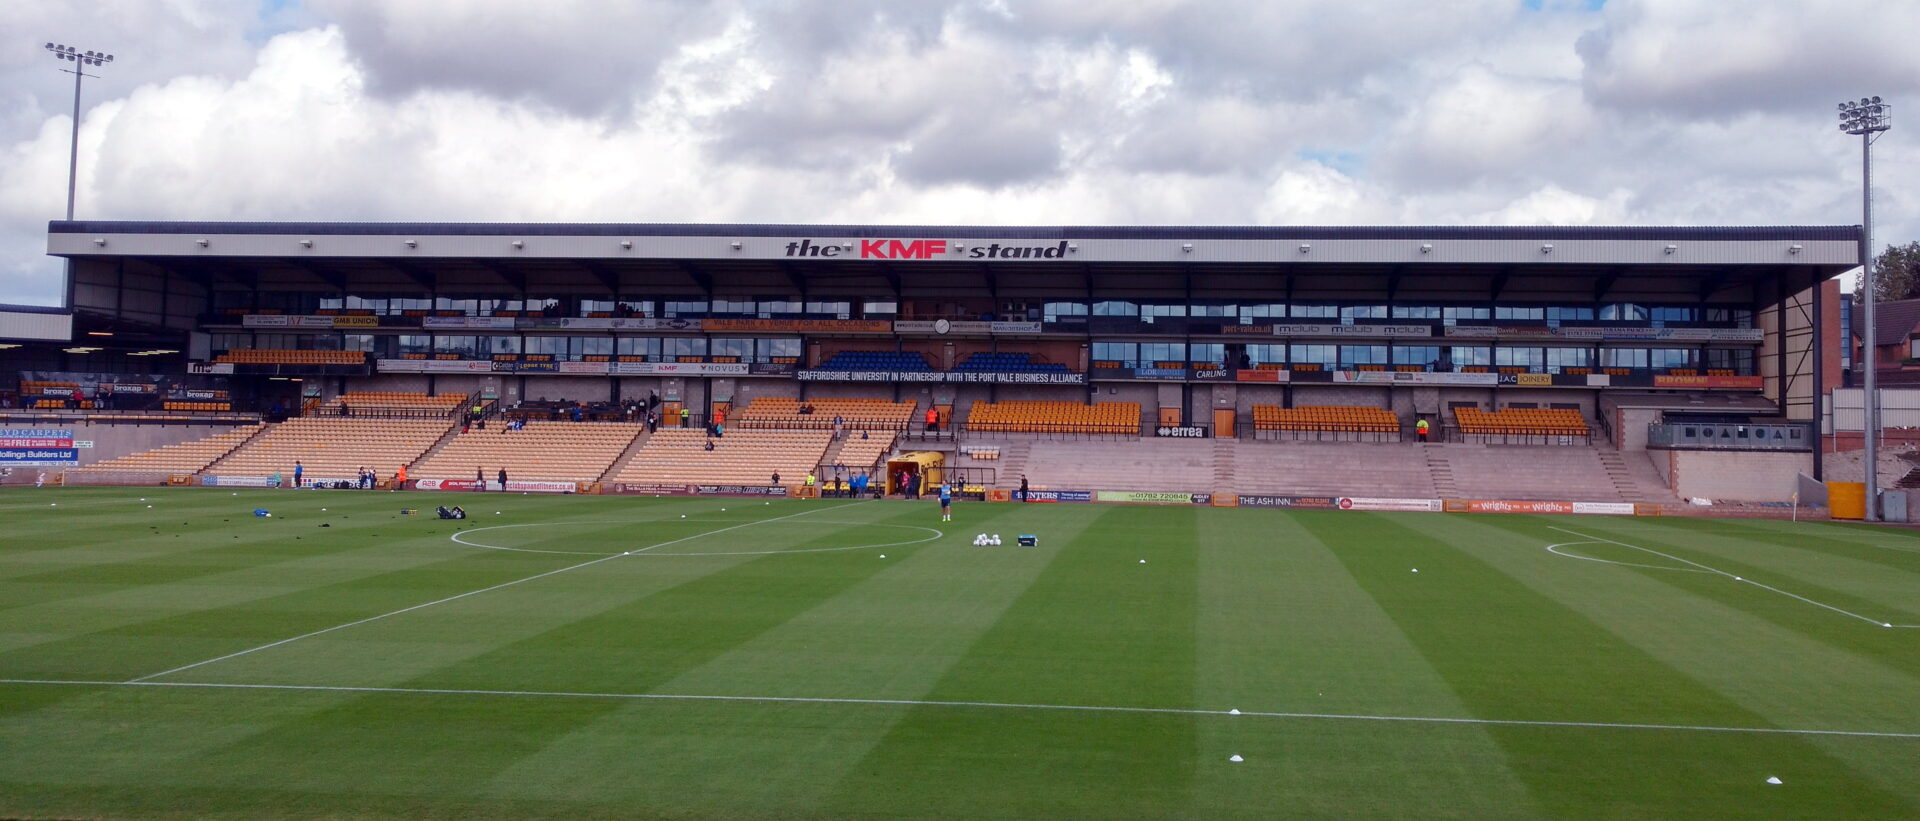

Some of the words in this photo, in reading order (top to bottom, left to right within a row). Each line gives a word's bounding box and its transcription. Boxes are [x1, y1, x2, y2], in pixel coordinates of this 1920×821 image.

[785, 239, 841, 257] the
[861, 240, 946, 259] KMF
[969, 240, 1068, 258] stand
[798, 371, 850, 381] STAFFORDSHIRE
[852, 372, 889, 381] UNIVERSITY
[892, 372, 898, 381] IN
[900, 372, 944, 382] PARTNERSHIP
[946, 372, 962, 382] WITH
[964, 372, 977, 382] THE
[978, 373, 995, 382] PORT
[997, 373, 1014, 382] VALE
[1016, 374, 1048, 383] BUSINESS
[1050, 374, 1082, 384] ALLIANCE
[1196, 370, 1226, 378] CARLING
[1519, 375, 1550, 383] JOINERY
[44, 388, 72, 396] broxap
[1172, 427, 1202, 437] errea
[1239, 497, 1254, 505] THE
[1256, 498, 1274, 506] ASH
[1276, 498, 1290, 506] INN
[1481, 501, 1512, 510] Wrights
[1532, 501, 1562, 511] Wrights
